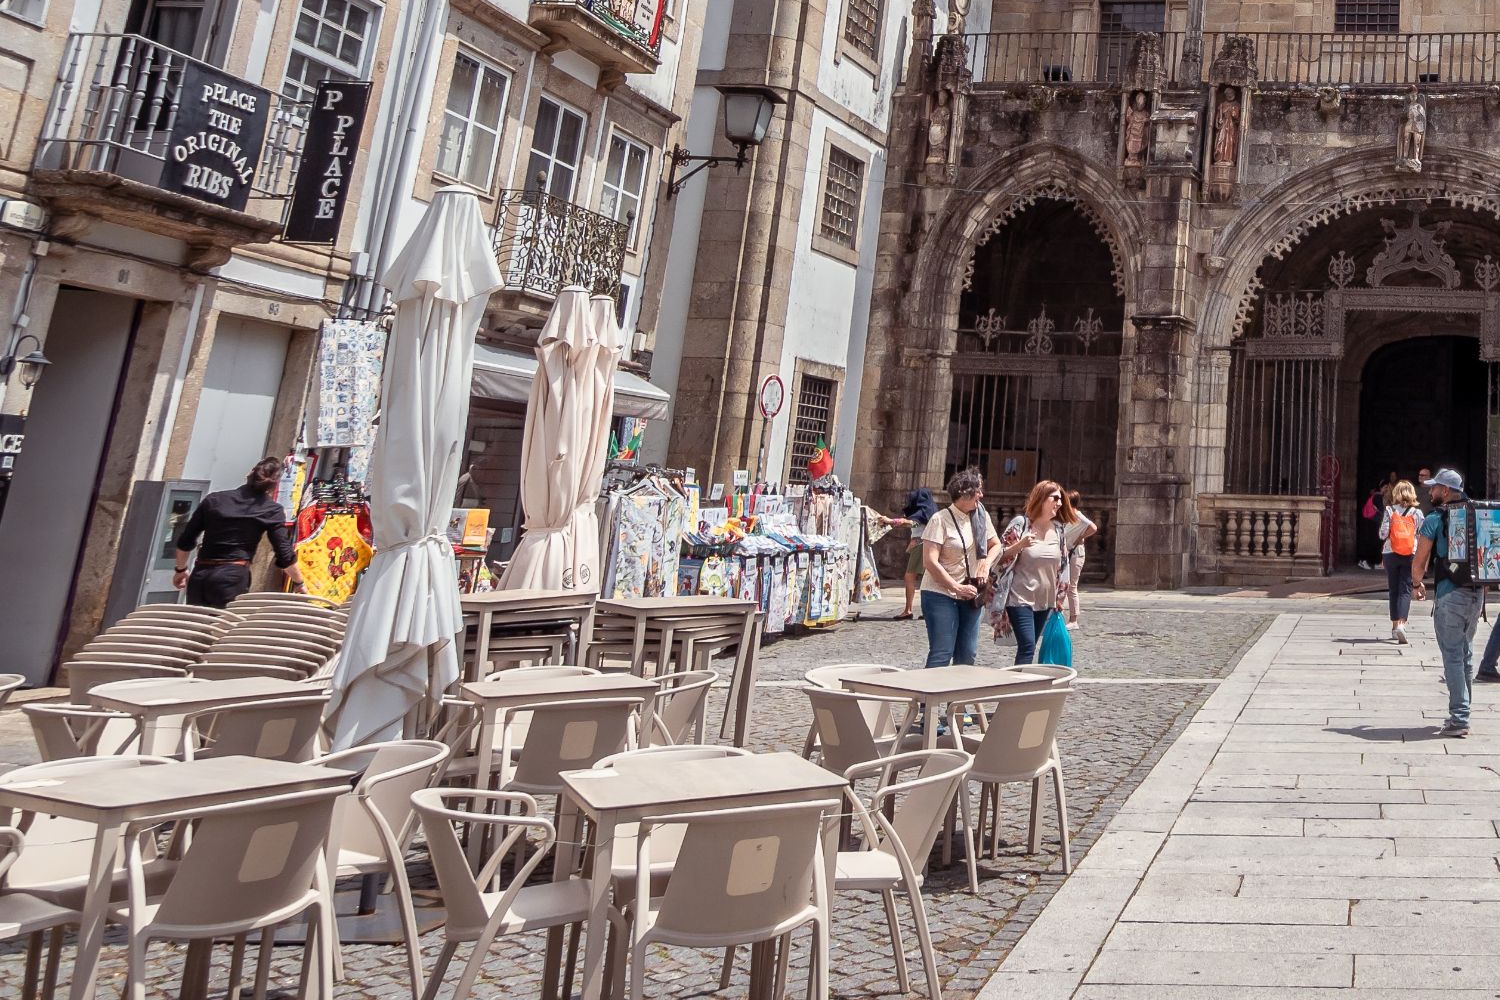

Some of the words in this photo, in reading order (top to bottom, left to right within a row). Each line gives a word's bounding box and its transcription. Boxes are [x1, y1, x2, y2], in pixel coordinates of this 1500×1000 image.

[322, 90, 343, 110] P
[208, 108, 243, 135] THE
[174, 131, 254, 185] ORIGINAL
[315, 115, 355, 219] PLACE
[184, 163, 234, 199] RIBS
[0, 433, 25, 454] CE
